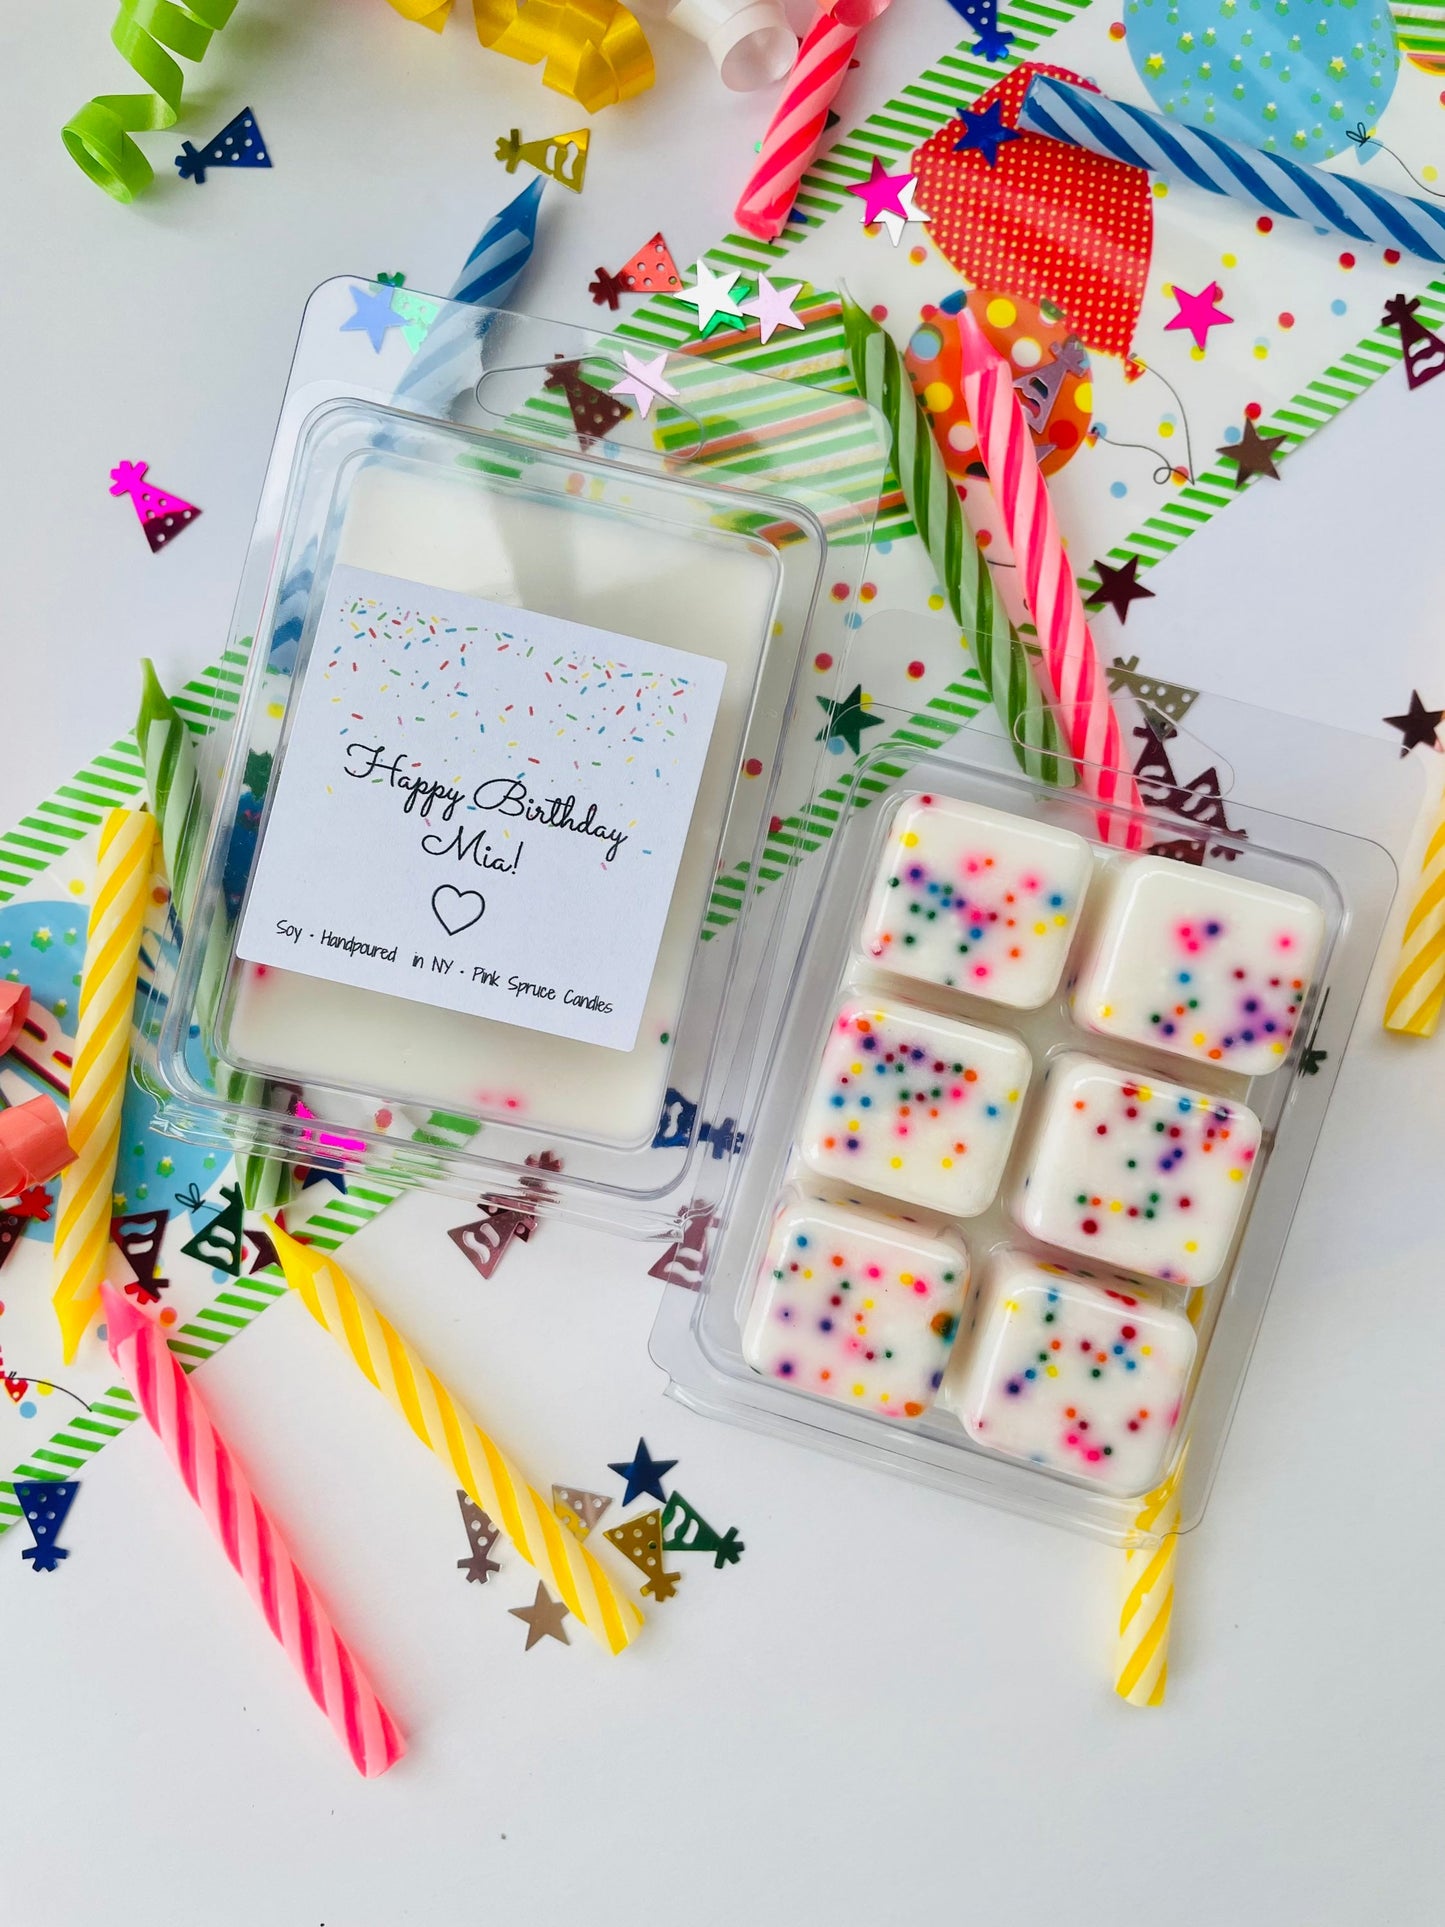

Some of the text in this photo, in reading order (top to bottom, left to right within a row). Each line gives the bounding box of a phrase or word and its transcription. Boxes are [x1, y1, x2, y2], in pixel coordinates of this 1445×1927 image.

[343, 743, 628, 862] Happy Birthday
[421, 825, 524, 875] Mia!
[275, 918, 614, 1014] Soy Handpoured in NY Pink Spruce Candles
